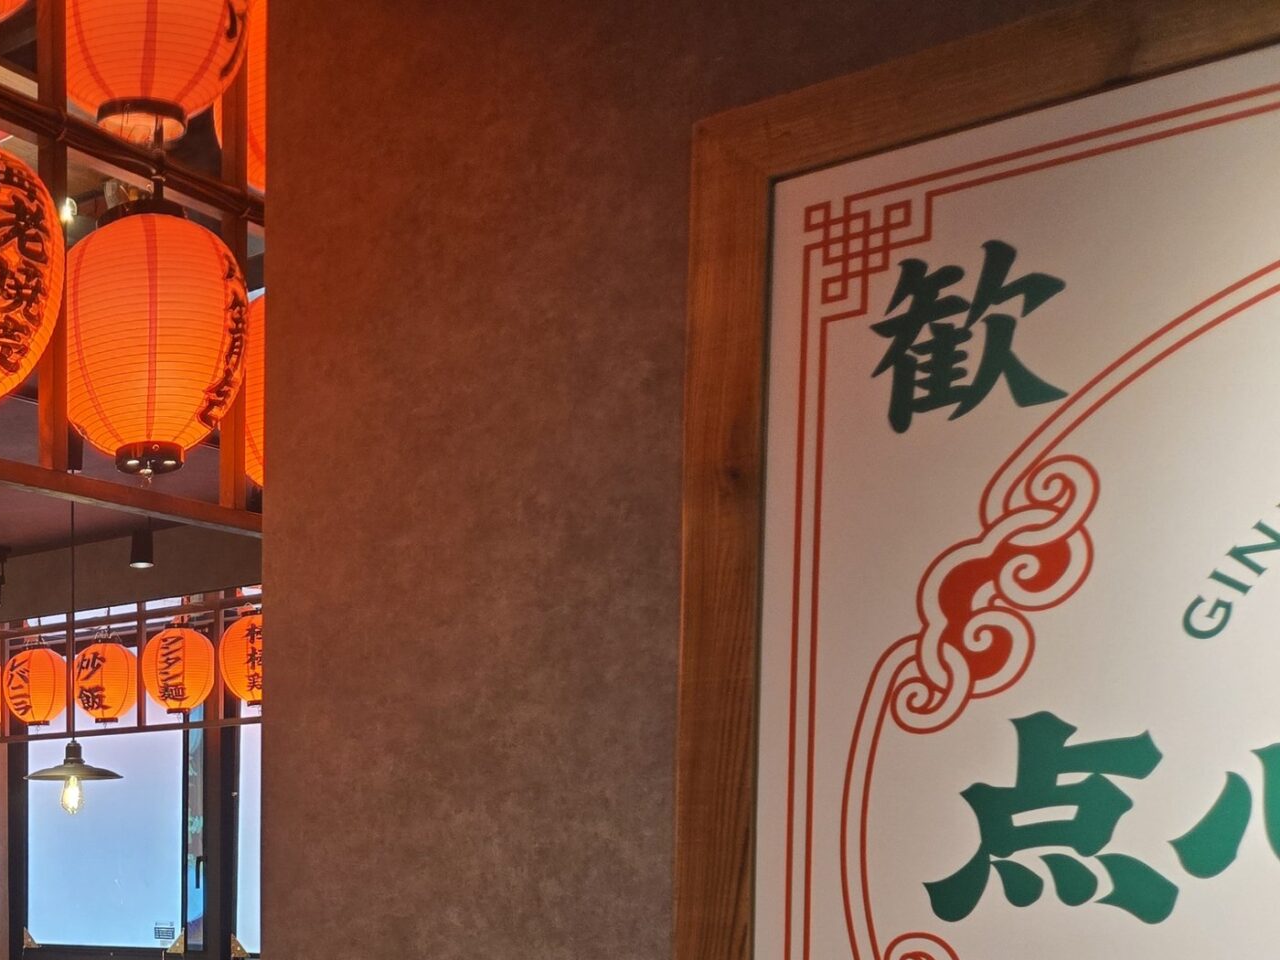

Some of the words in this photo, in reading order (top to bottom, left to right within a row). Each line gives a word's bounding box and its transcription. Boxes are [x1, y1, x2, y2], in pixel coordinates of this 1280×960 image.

[869, 239, 1069, 433] 歓
[1182, 503, 1280, 640] GIN
[7, 658, 32, 716] レバニラ
[76, 652, 112, 711] 炒飯
[158, 635, 190, 701] ワンタン麺
[922, 710, 1280, 925] 点
